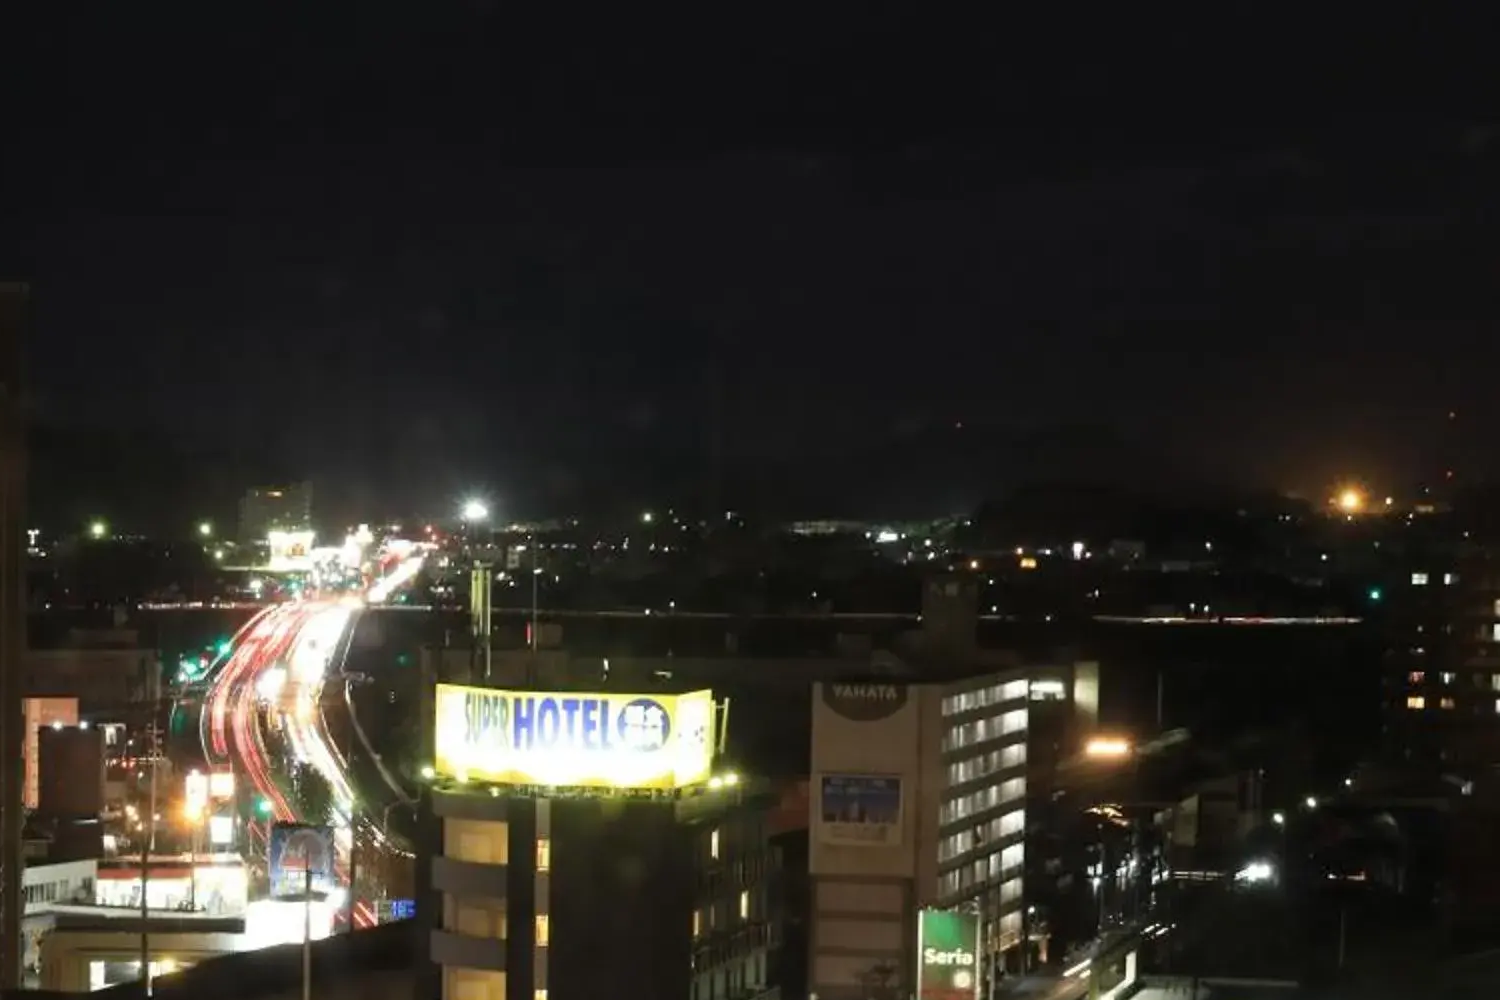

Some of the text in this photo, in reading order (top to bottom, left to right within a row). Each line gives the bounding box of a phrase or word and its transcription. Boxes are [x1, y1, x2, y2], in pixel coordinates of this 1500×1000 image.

[465, 692, 612, 751] SUPER HOTEL
[924, 947, 974, 965] Seria
